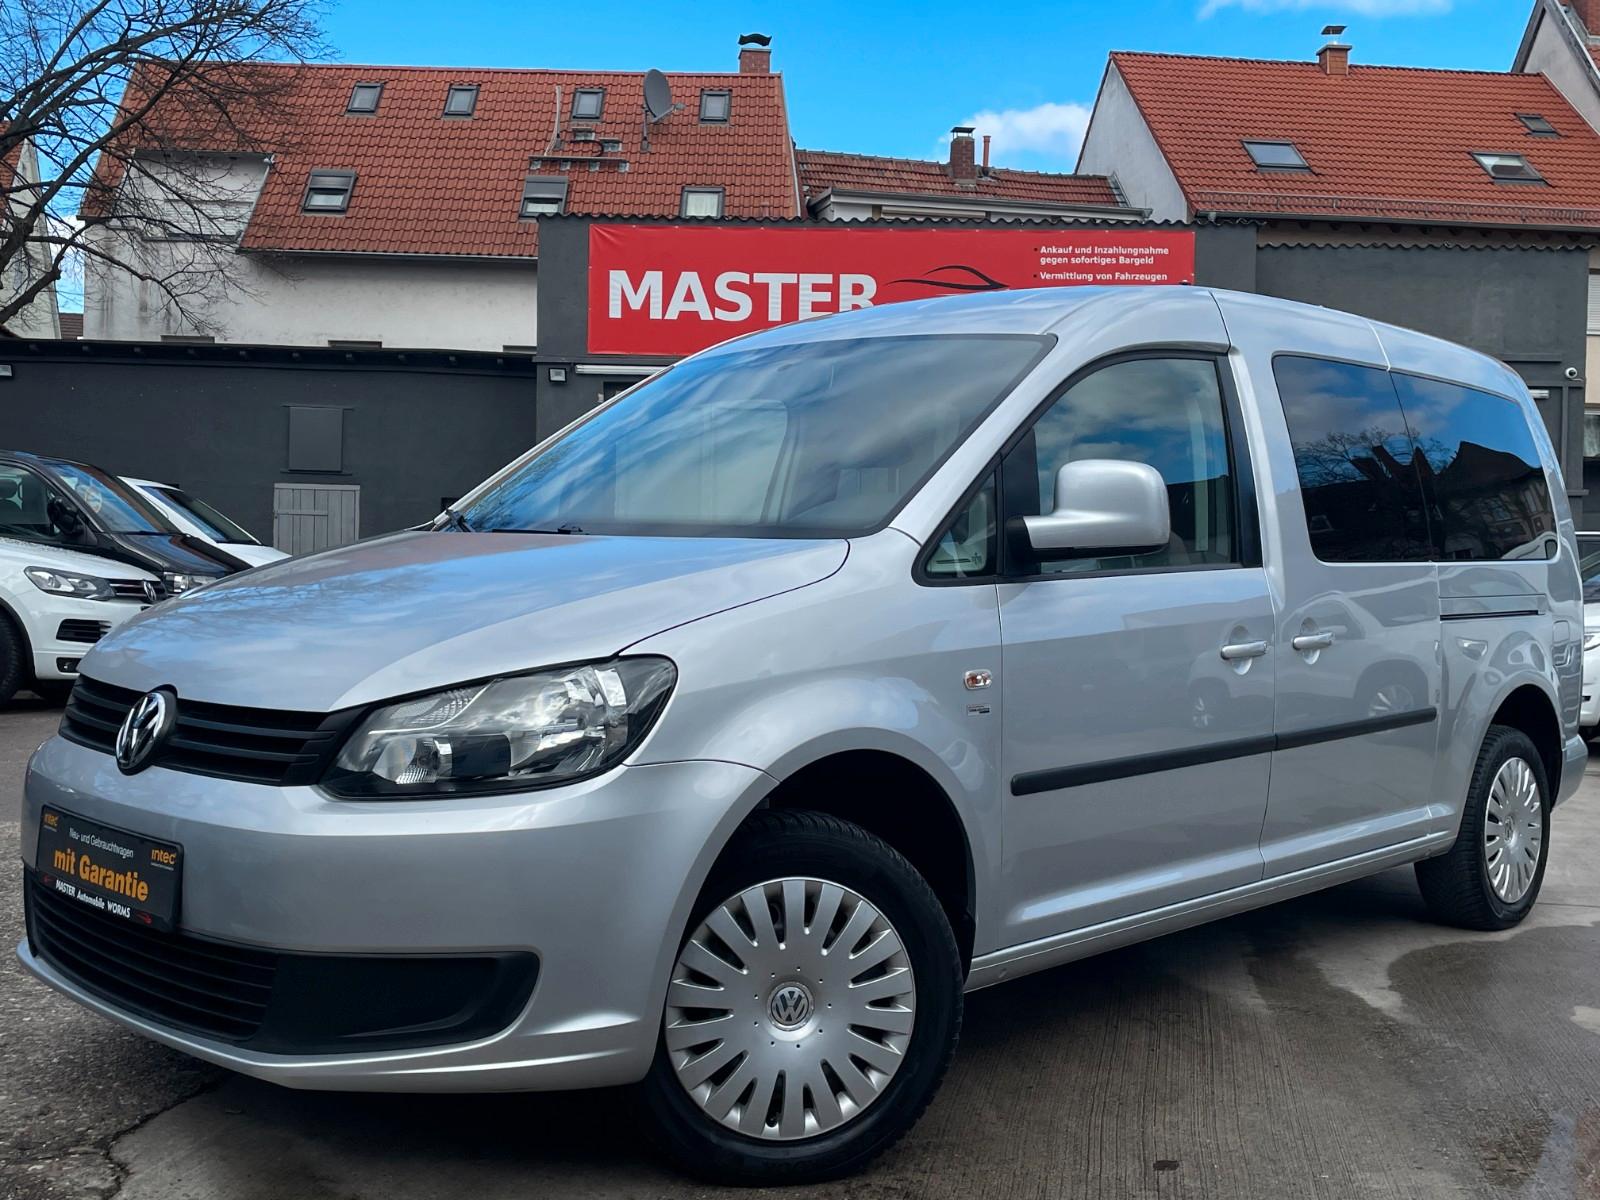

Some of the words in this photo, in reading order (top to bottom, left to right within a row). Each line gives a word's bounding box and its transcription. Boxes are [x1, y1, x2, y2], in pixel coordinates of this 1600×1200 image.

[1040, 246, 1072, 254] Ankauf
[1075, 246, 1092, 254] und
[1094, 246, 1169, 256] Inzahlungnahme
[1040, 257, 1068, 265] gegen
[1070, 256, 1117, 265] sofortiges
[1119, 256, 1154, 265] Bargeld
[1040, 272, 1093, 281] Vermittlung
[1115, 272, 1168, 281] Fahrzeugen
[608, 270, 877, 322] MASTER
[80, 831, 90, 845] und
[90, 834, 134, 859] Gebrauchtwagen
[54, 848, 76, 875] mit
[79, 854, 149, 902] Garantie
[55, 879, 76, 897] MASTER
[76, 889, 105, 909] Automobile
[107, 901, 131, 919] WORMS
